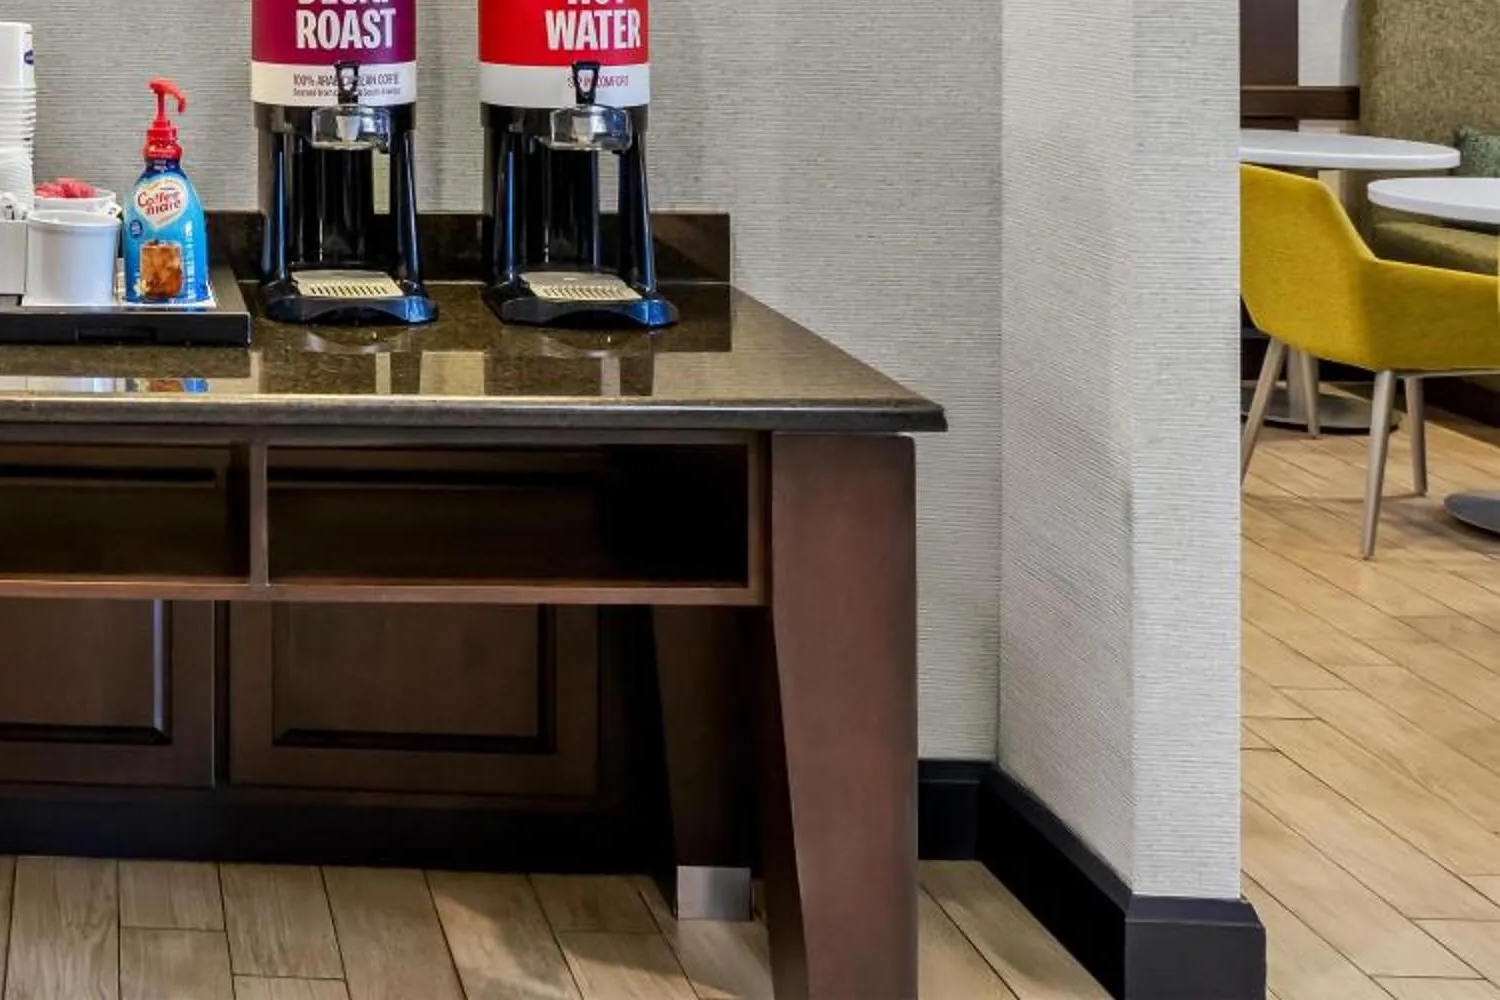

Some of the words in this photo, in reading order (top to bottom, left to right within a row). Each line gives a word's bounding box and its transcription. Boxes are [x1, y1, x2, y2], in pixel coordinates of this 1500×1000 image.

[296, 8, 396, 49] ROAST
[545, 9, 642, 51] WATER
[146, 199, 181, 216] mate
